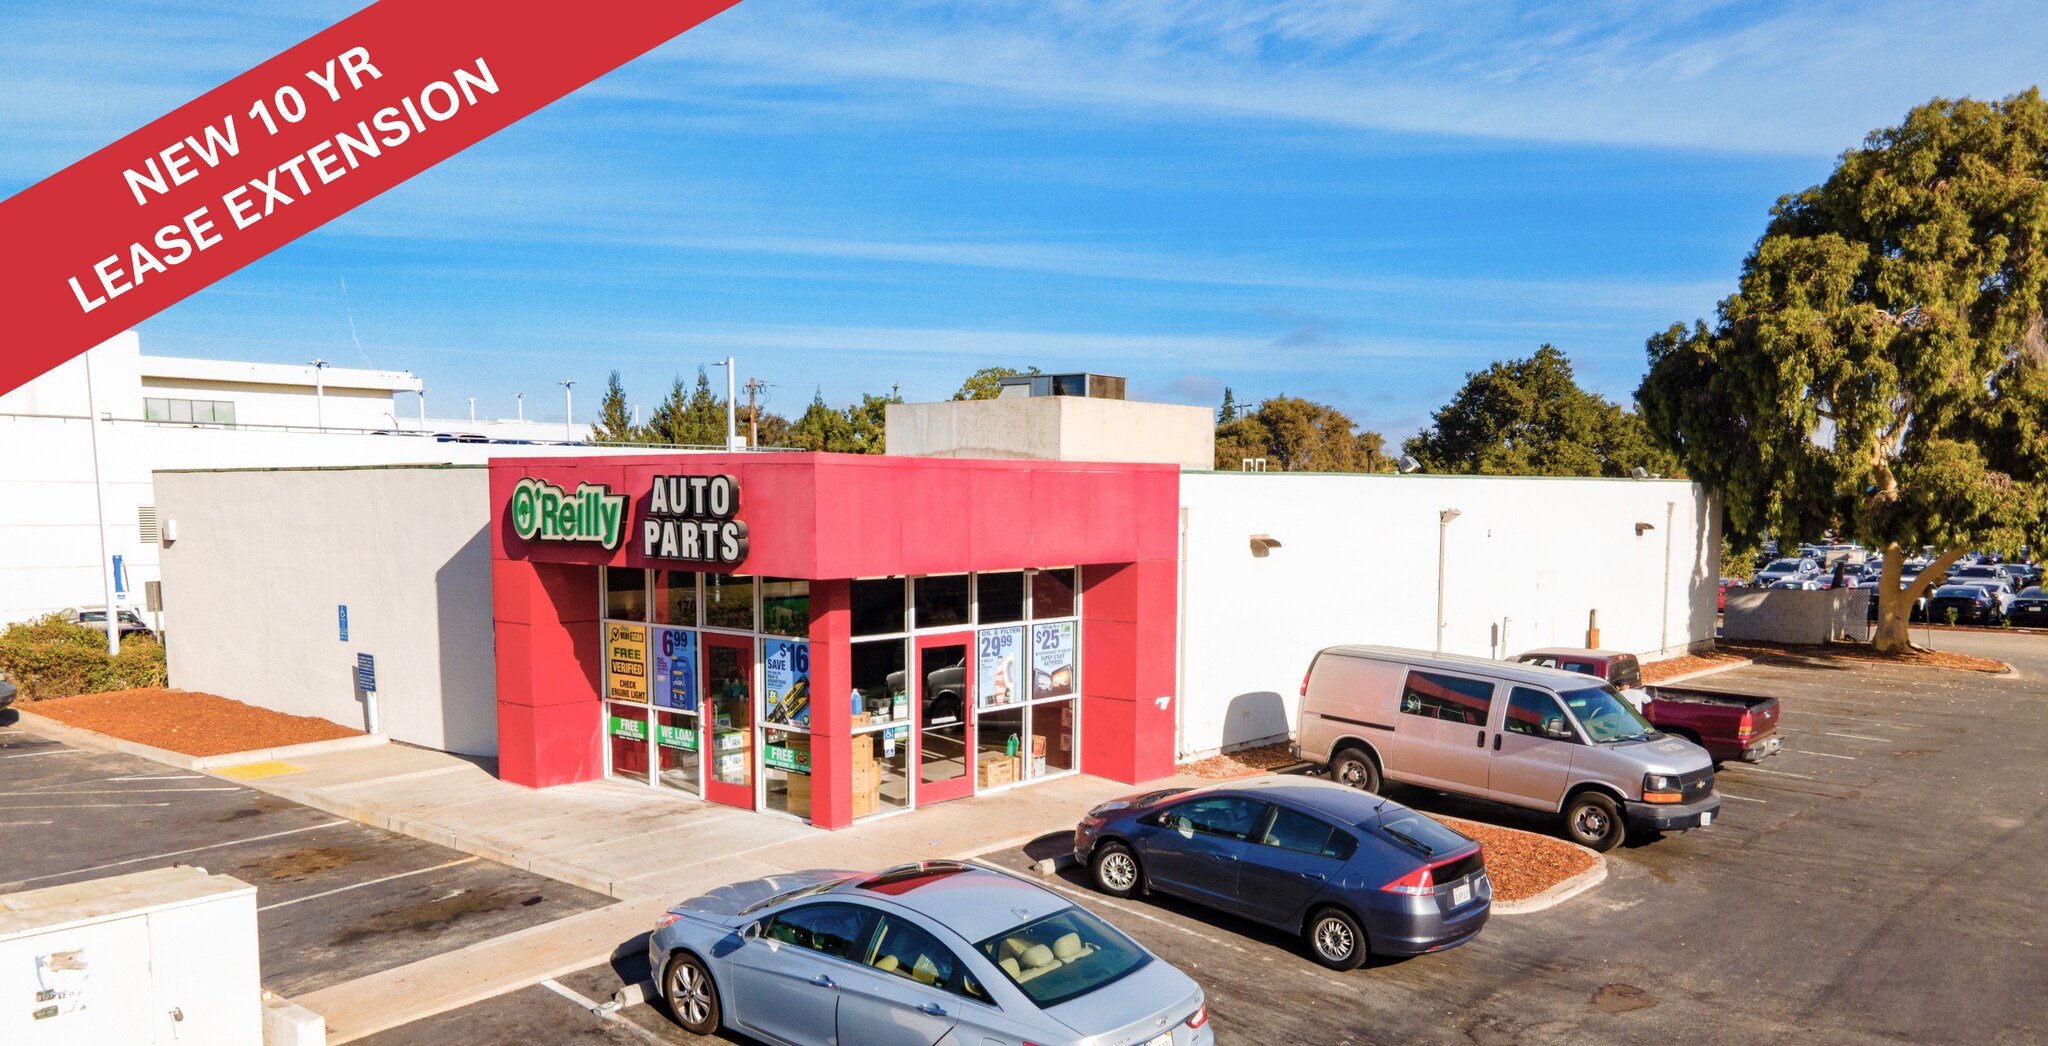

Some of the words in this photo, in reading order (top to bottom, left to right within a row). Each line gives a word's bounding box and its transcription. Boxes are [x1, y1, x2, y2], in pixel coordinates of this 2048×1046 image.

[650, 475, 732, 517] AUTO
[512, 484, 619, 546] O'Reilly
[643, 519, 741, 562] PARTS
[613, 647, 641, 660] FREE
[612, 660, 643, 676] VERIFIED
[767, 659, 786, 671] SAVE
[619, 680, 637, 689] CHECK
[611, 688, 630, 698] ENGINE
[630, 690, 646, 700] LIGHT
[620, 719, 639, 733] FREE
[661, 726, 673, 739] WE
[771, 747, 794, 763] FREE
